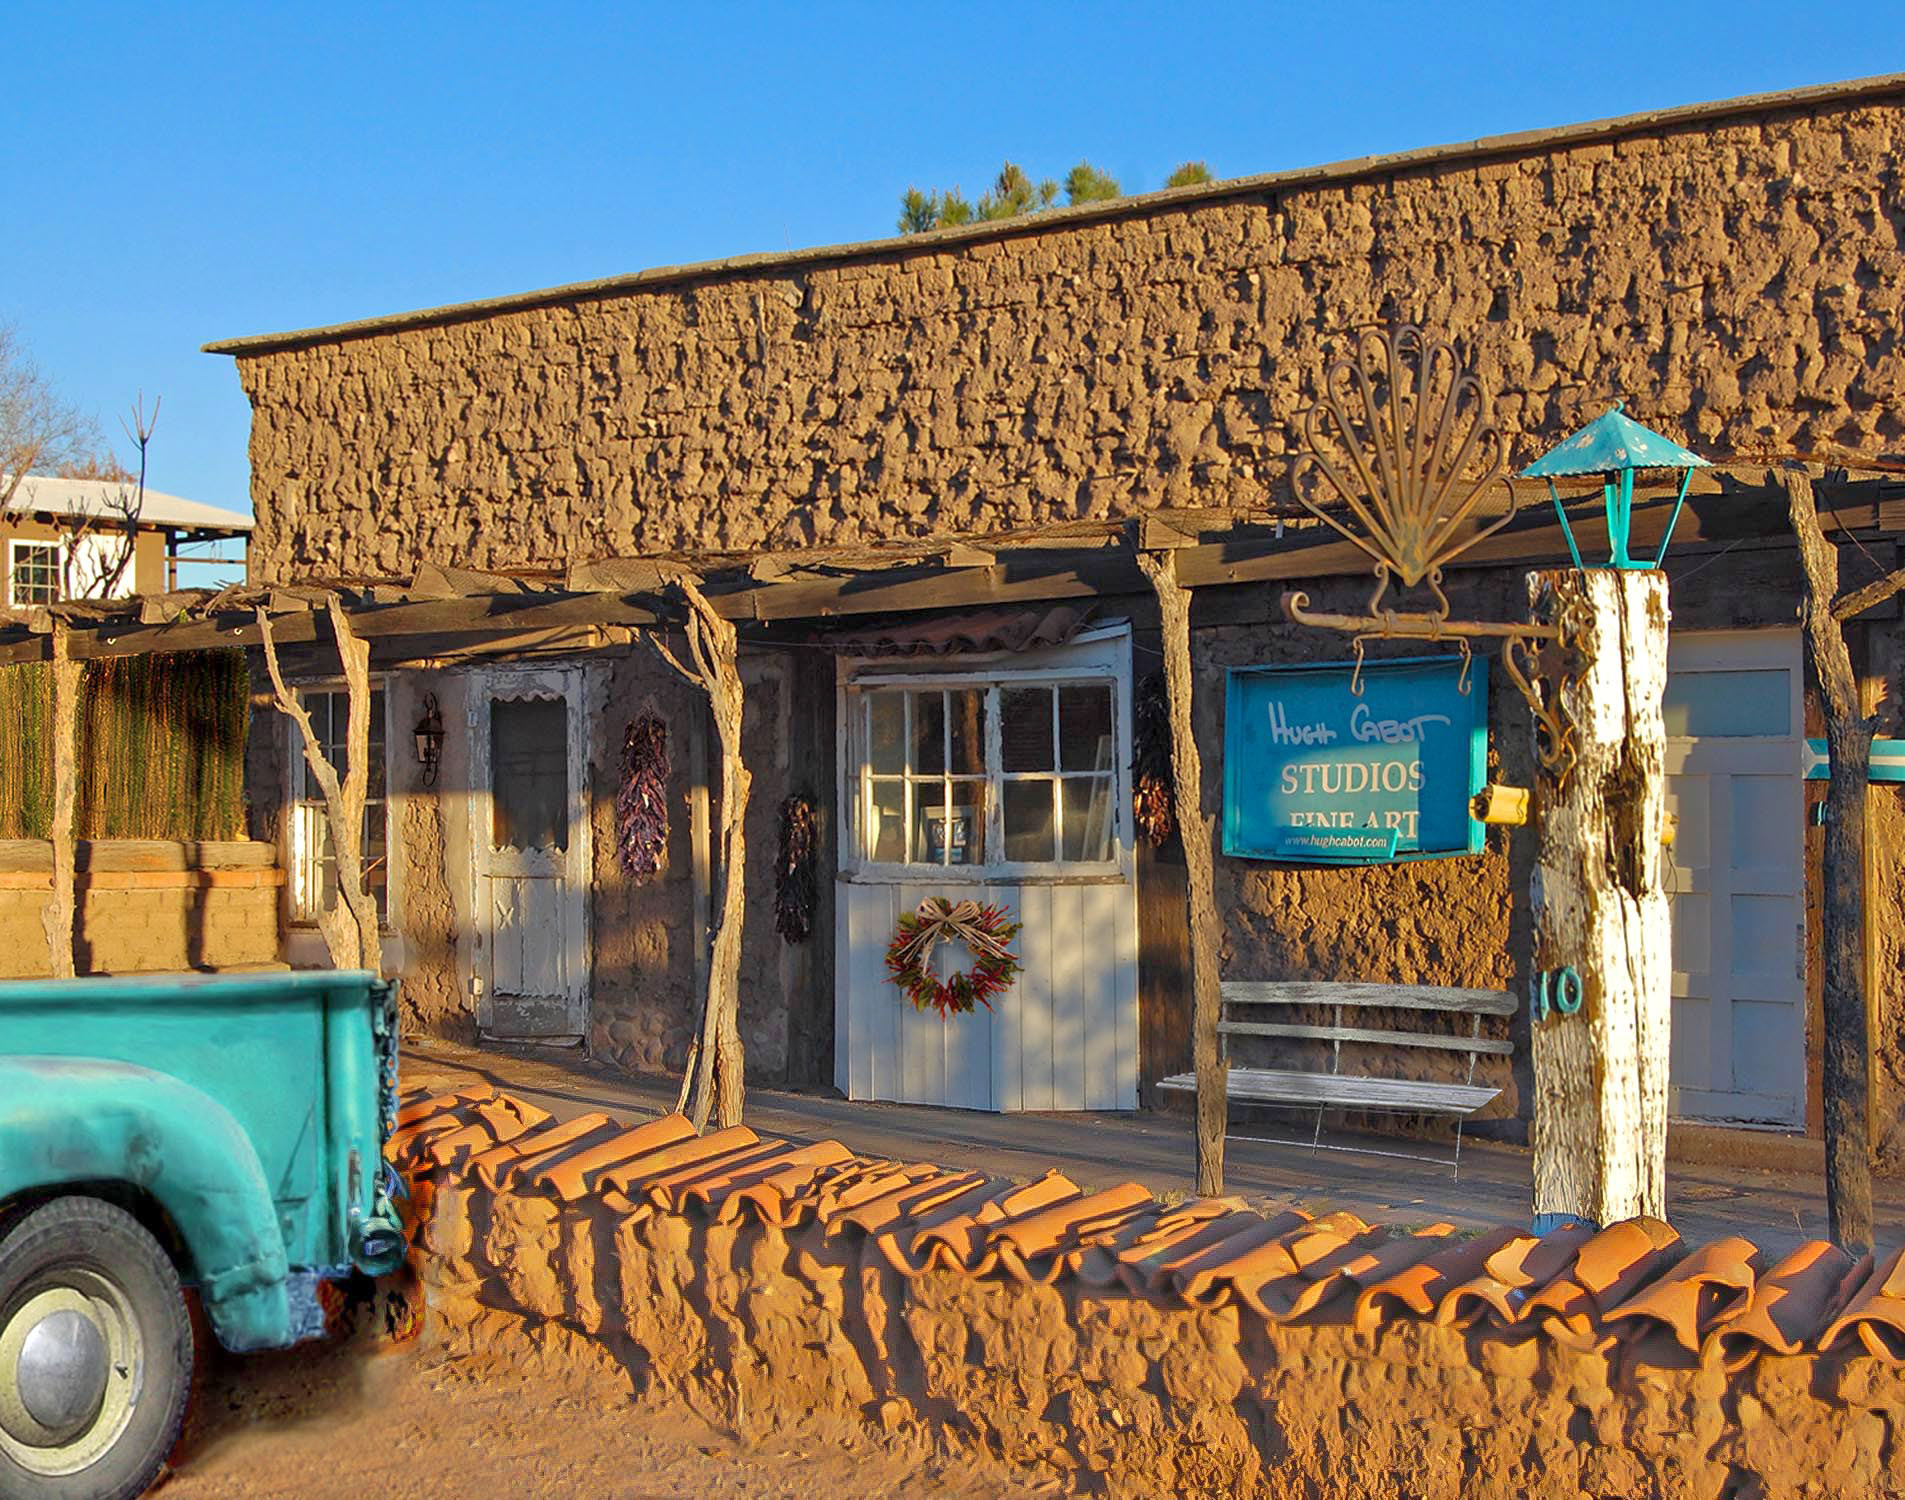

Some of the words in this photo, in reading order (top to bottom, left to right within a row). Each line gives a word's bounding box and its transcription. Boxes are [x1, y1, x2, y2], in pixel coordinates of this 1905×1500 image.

[1281, 760, 1426, 794] STUDIOS
[1362, 810, 1420, 838] ART
[1285, 834, 1387, 848] www.hughcabot.com
